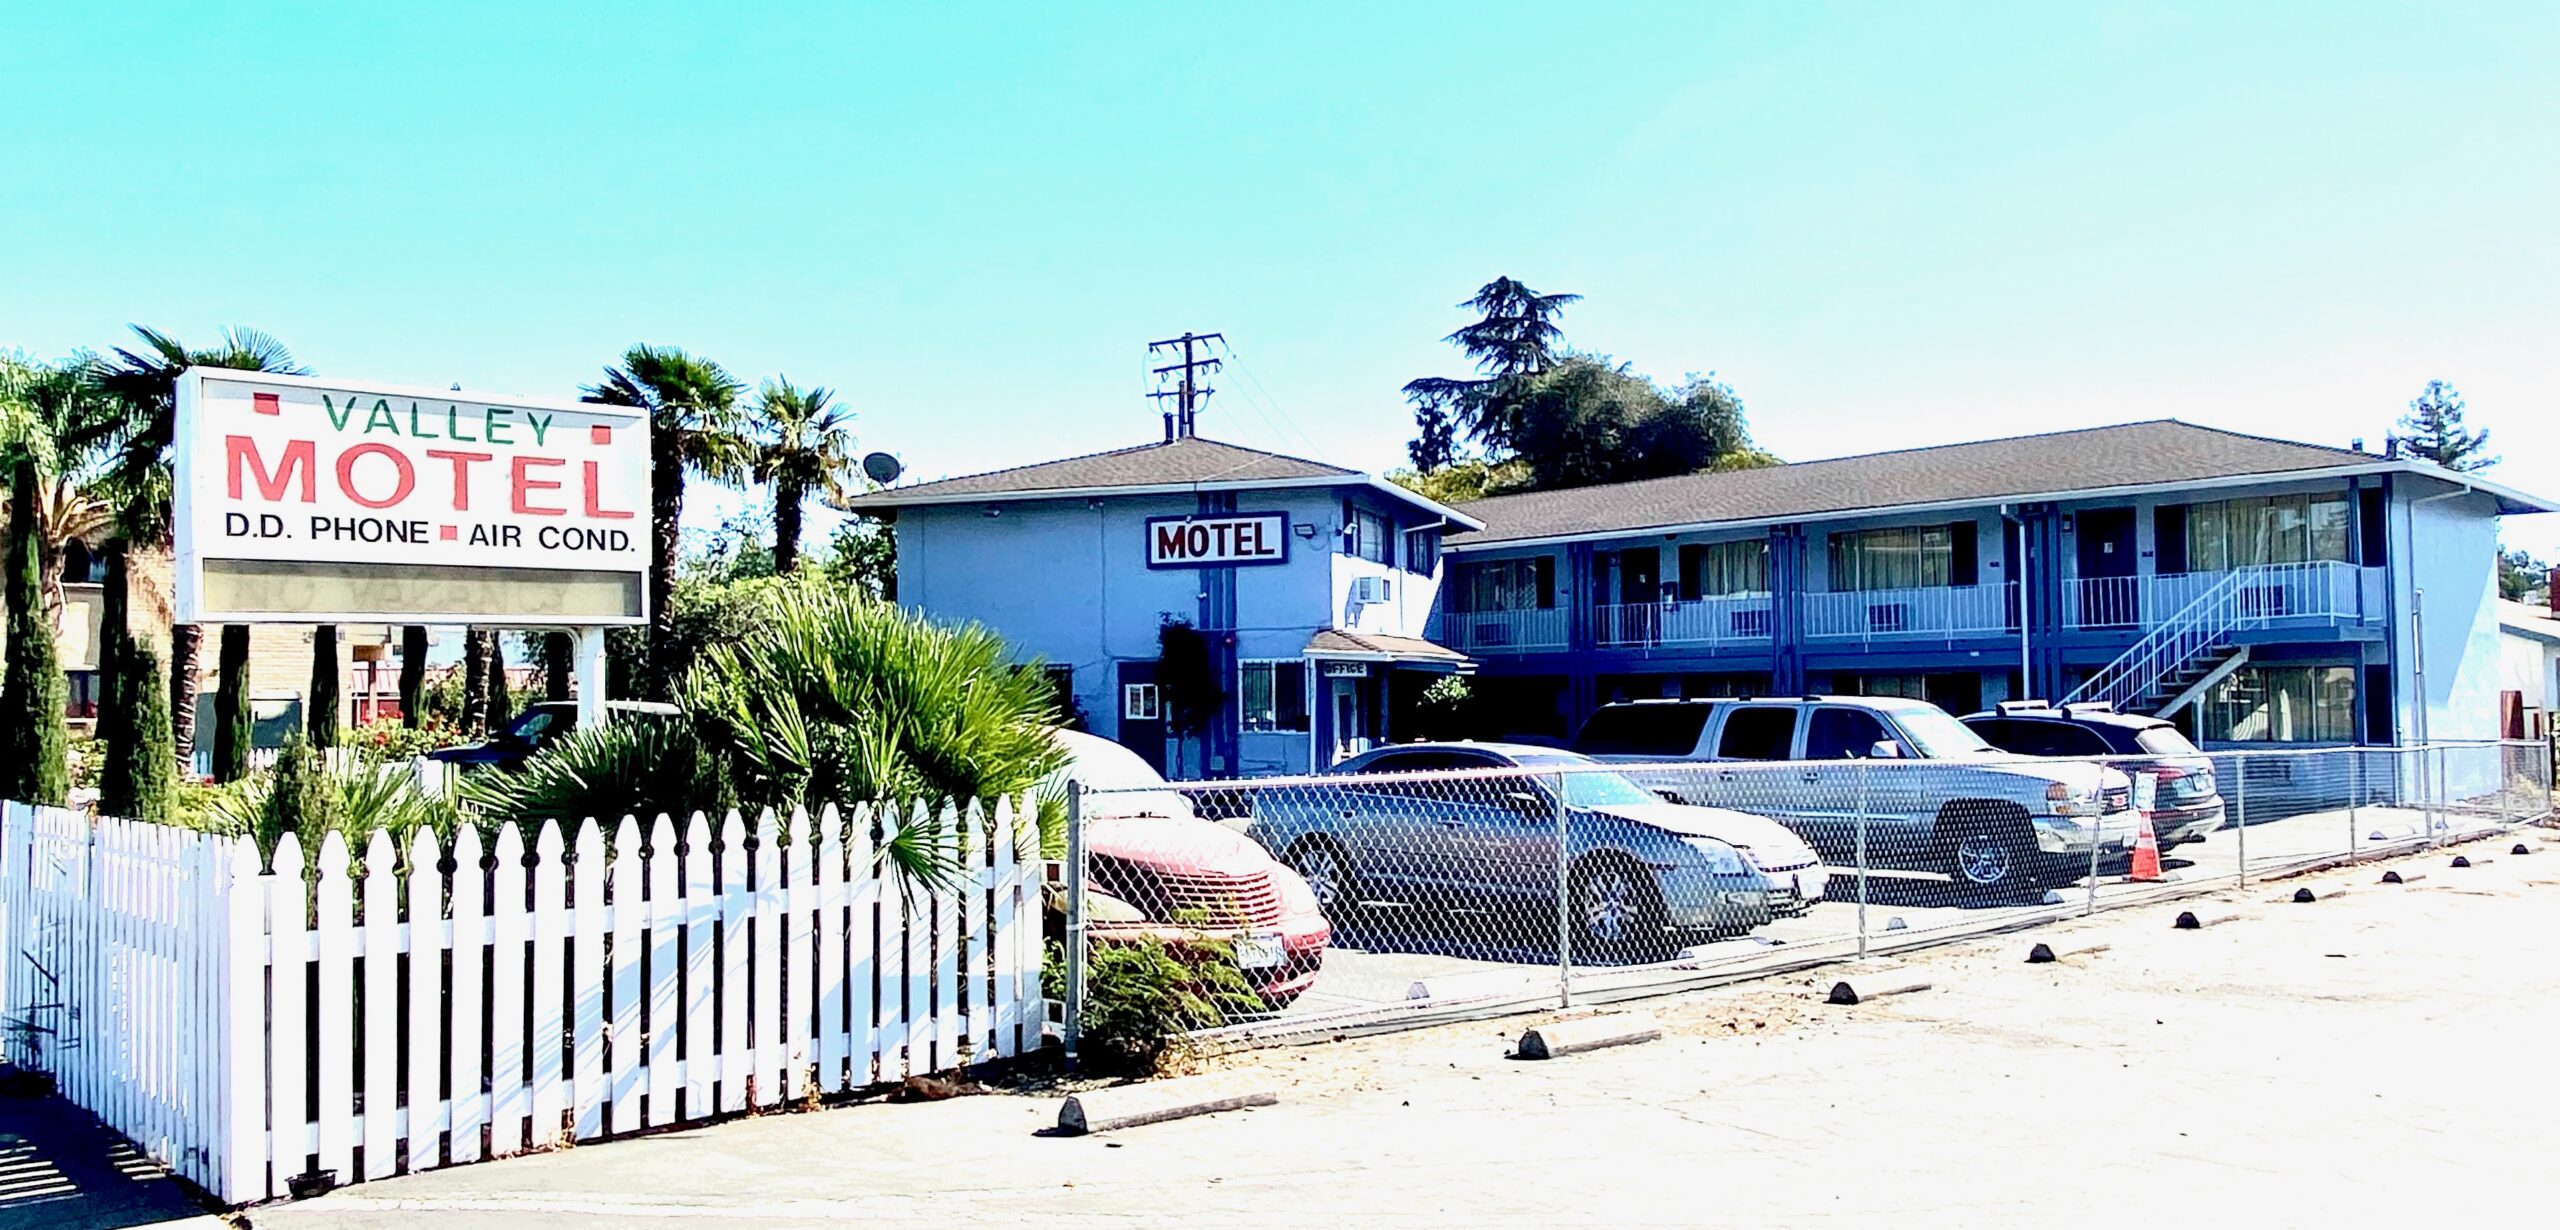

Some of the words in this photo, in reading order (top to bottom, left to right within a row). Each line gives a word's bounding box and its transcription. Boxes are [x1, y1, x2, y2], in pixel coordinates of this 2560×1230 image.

[322, 394, 553, 447] VALLEY
[225, 434, 635, 520] MOTEL
[225, 512, 292, 538] D.D.
[311, 516, 429, 544] PHONE
[469, 523, 521, 548] AIR
[538, 526, 636, 553] COND.
[1157, 521, 1275, 560] MOTEL
[1324, 662, 1365, 675] OFFICE
